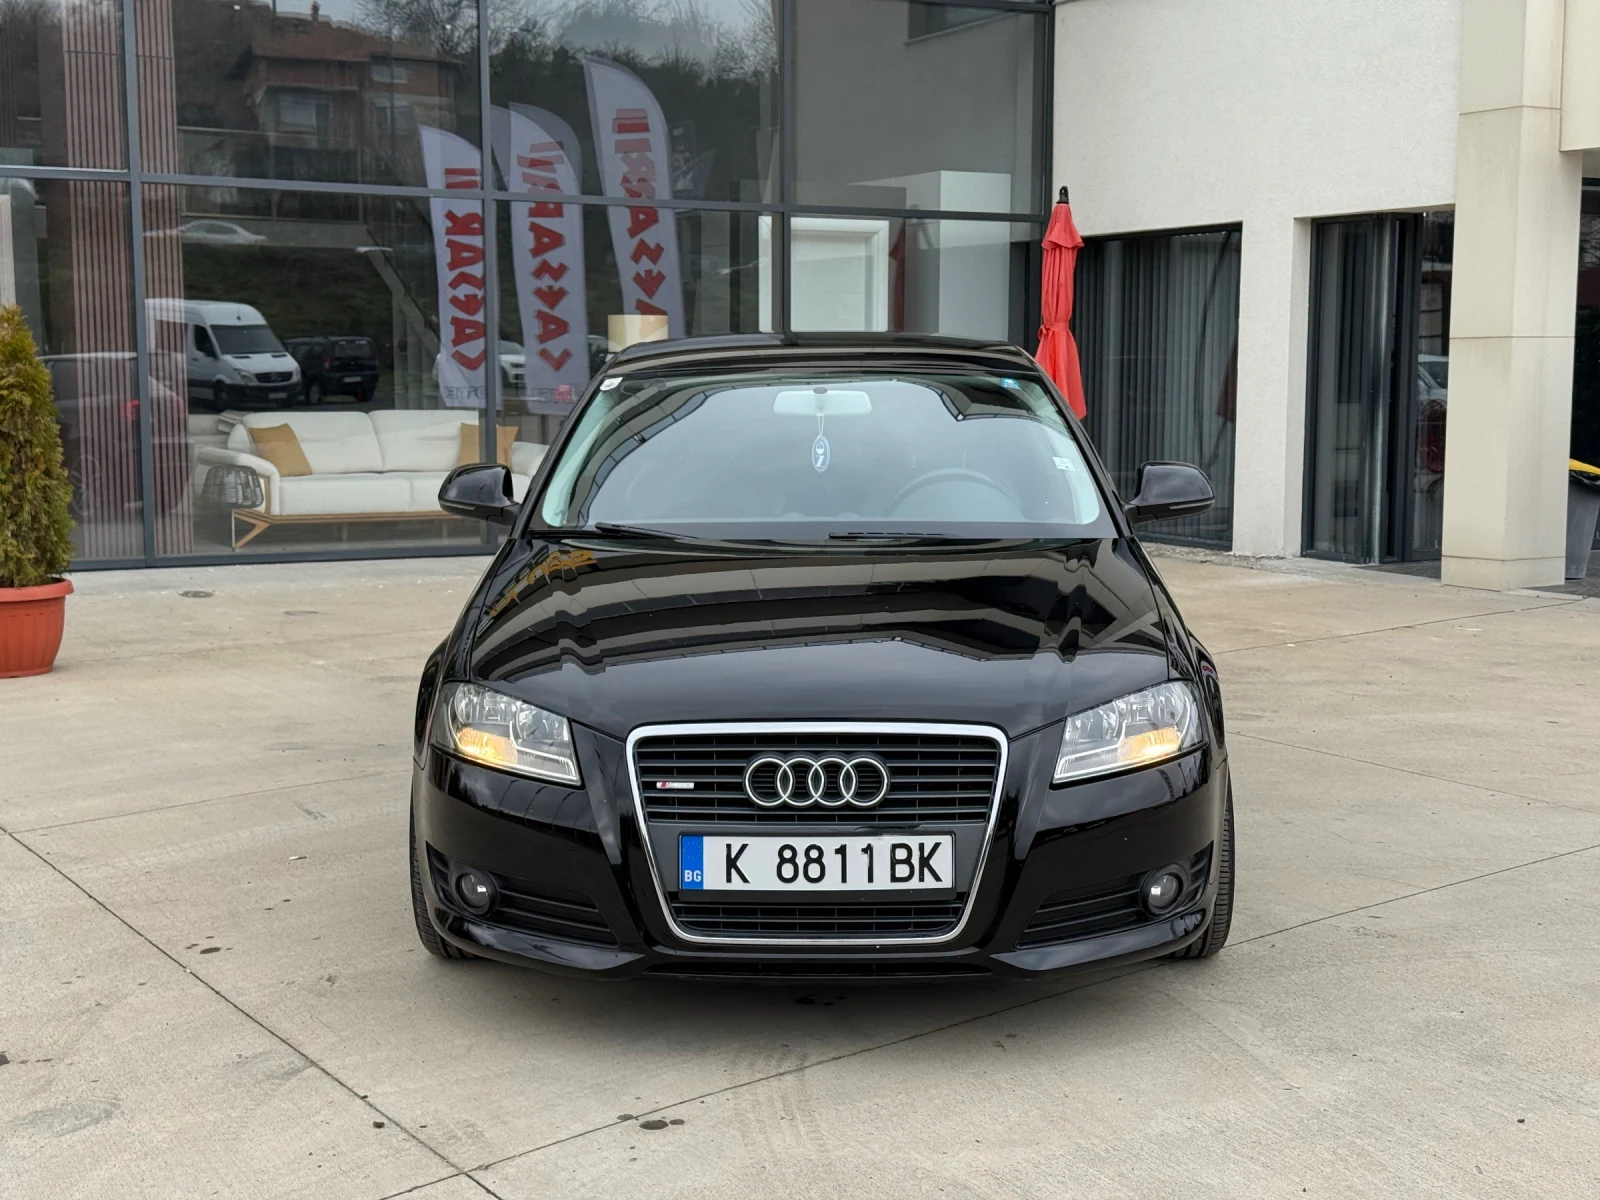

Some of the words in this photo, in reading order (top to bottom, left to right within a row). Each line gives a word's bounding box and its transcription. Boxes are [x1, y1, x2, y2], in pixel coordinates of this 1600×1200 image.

[684, 870, 702, 883] BG
[725, 843, 750, 884] K
[776, 842, 944, 884] 8811BK
